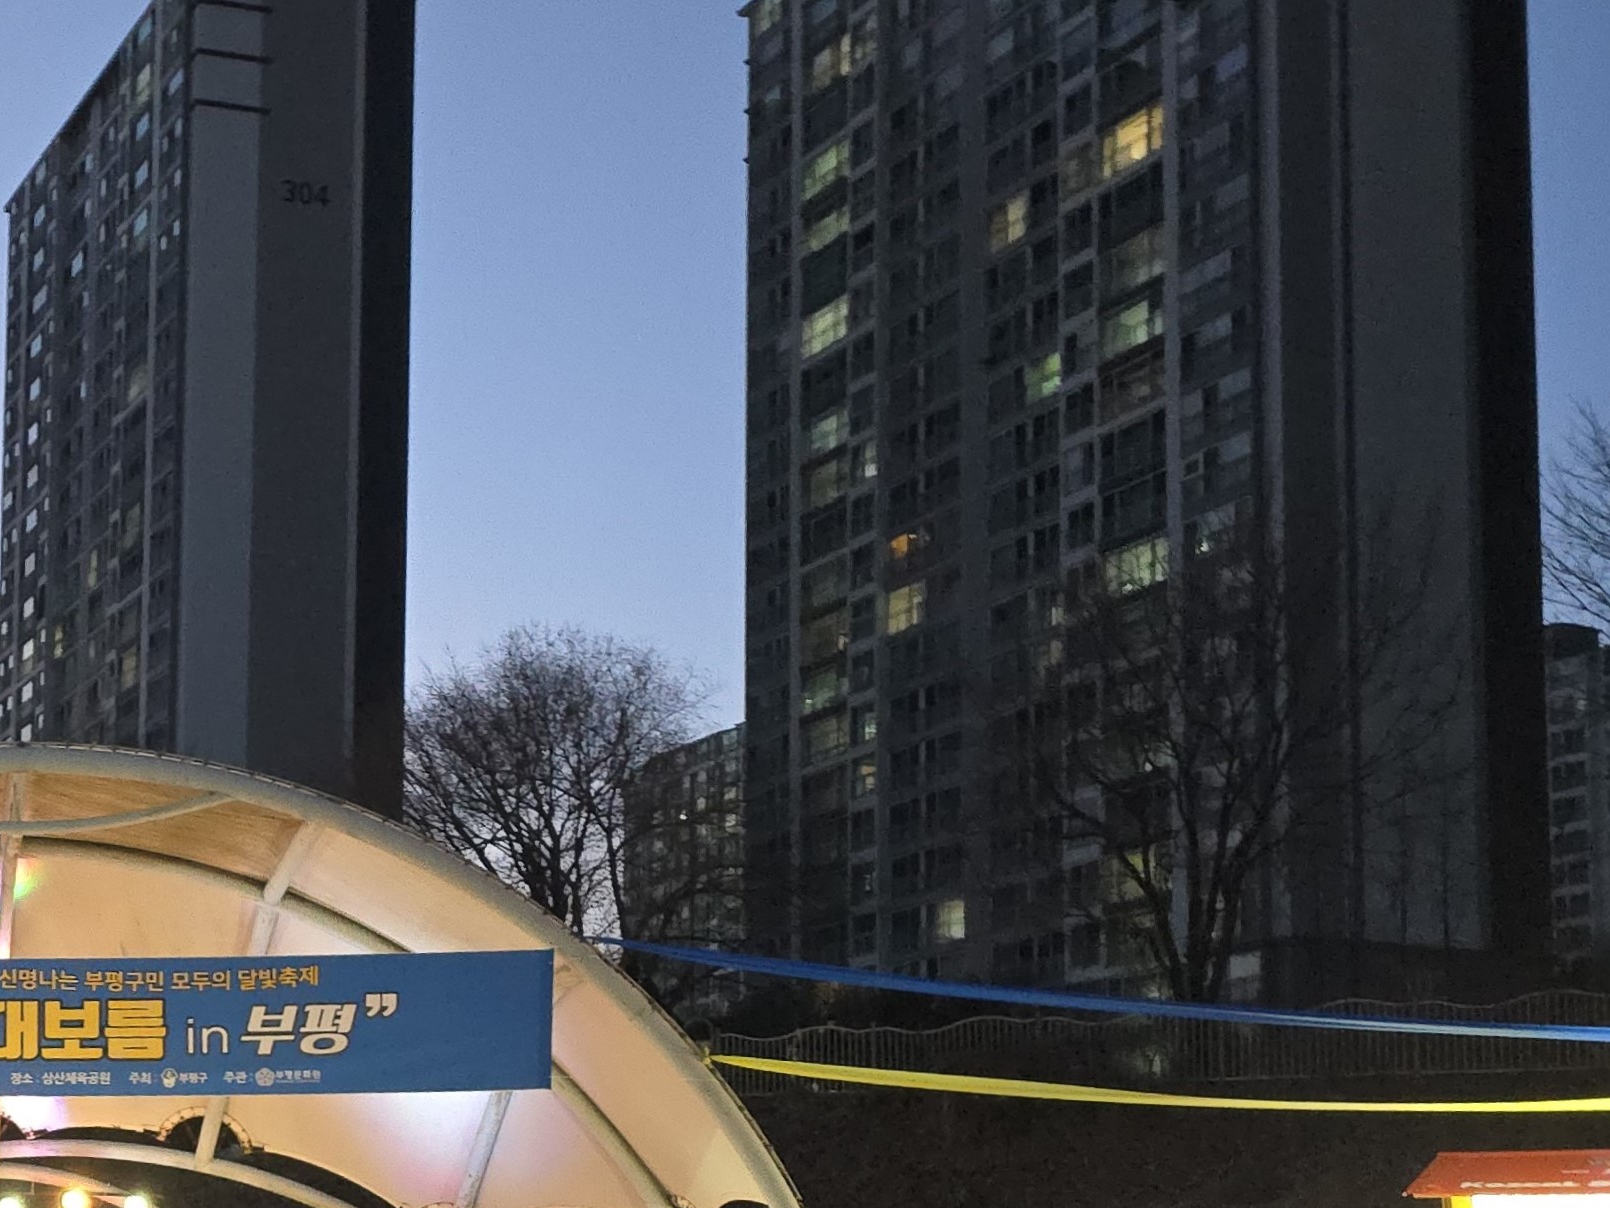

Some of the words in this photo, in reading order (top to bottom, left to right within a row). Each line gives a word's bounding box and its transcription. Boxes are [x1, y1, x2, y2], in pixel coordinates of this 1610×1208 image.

[280, 180, 330, 207] 304
[83, 970, 164, 992] 부평구민
[170, 969, 231, 991] 모두의
[237, 966, 319, 990] 달빛축제
[186, 1018, 230, 1055] in
[10, 1072, 34, 1085] 장소
[41, 1071, 111, 1085] 삼산체육공원
[129, 1071, 152, 1085] 주최
[179, 1072, 208, 1084] 부평구
[223, 1071, 247, 1084] 주관
